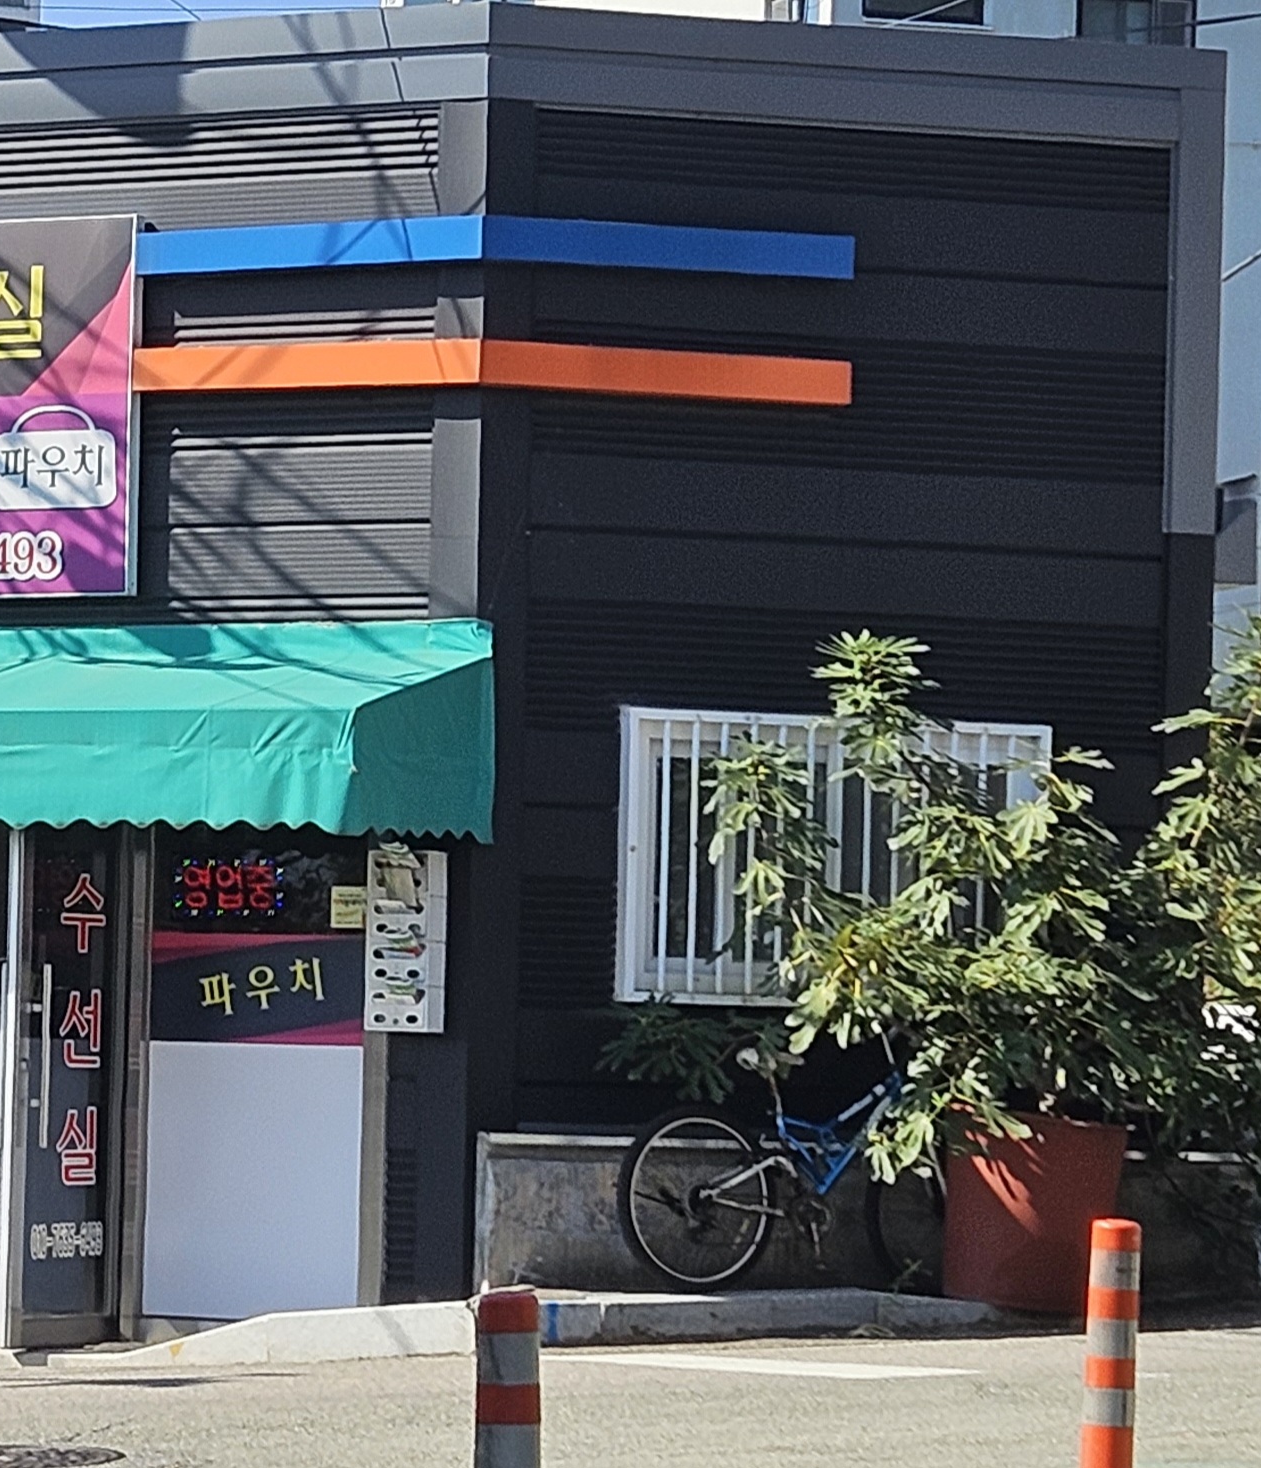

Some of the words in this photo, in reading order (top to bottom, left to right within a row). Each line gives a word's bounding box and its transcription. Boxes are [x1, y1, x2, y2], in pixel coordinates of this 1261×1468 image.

[0, 444, 105, 488] 파우치
[183, 865, 274, 909] 영업중
[198, 956, 326, 1017] 파우치
